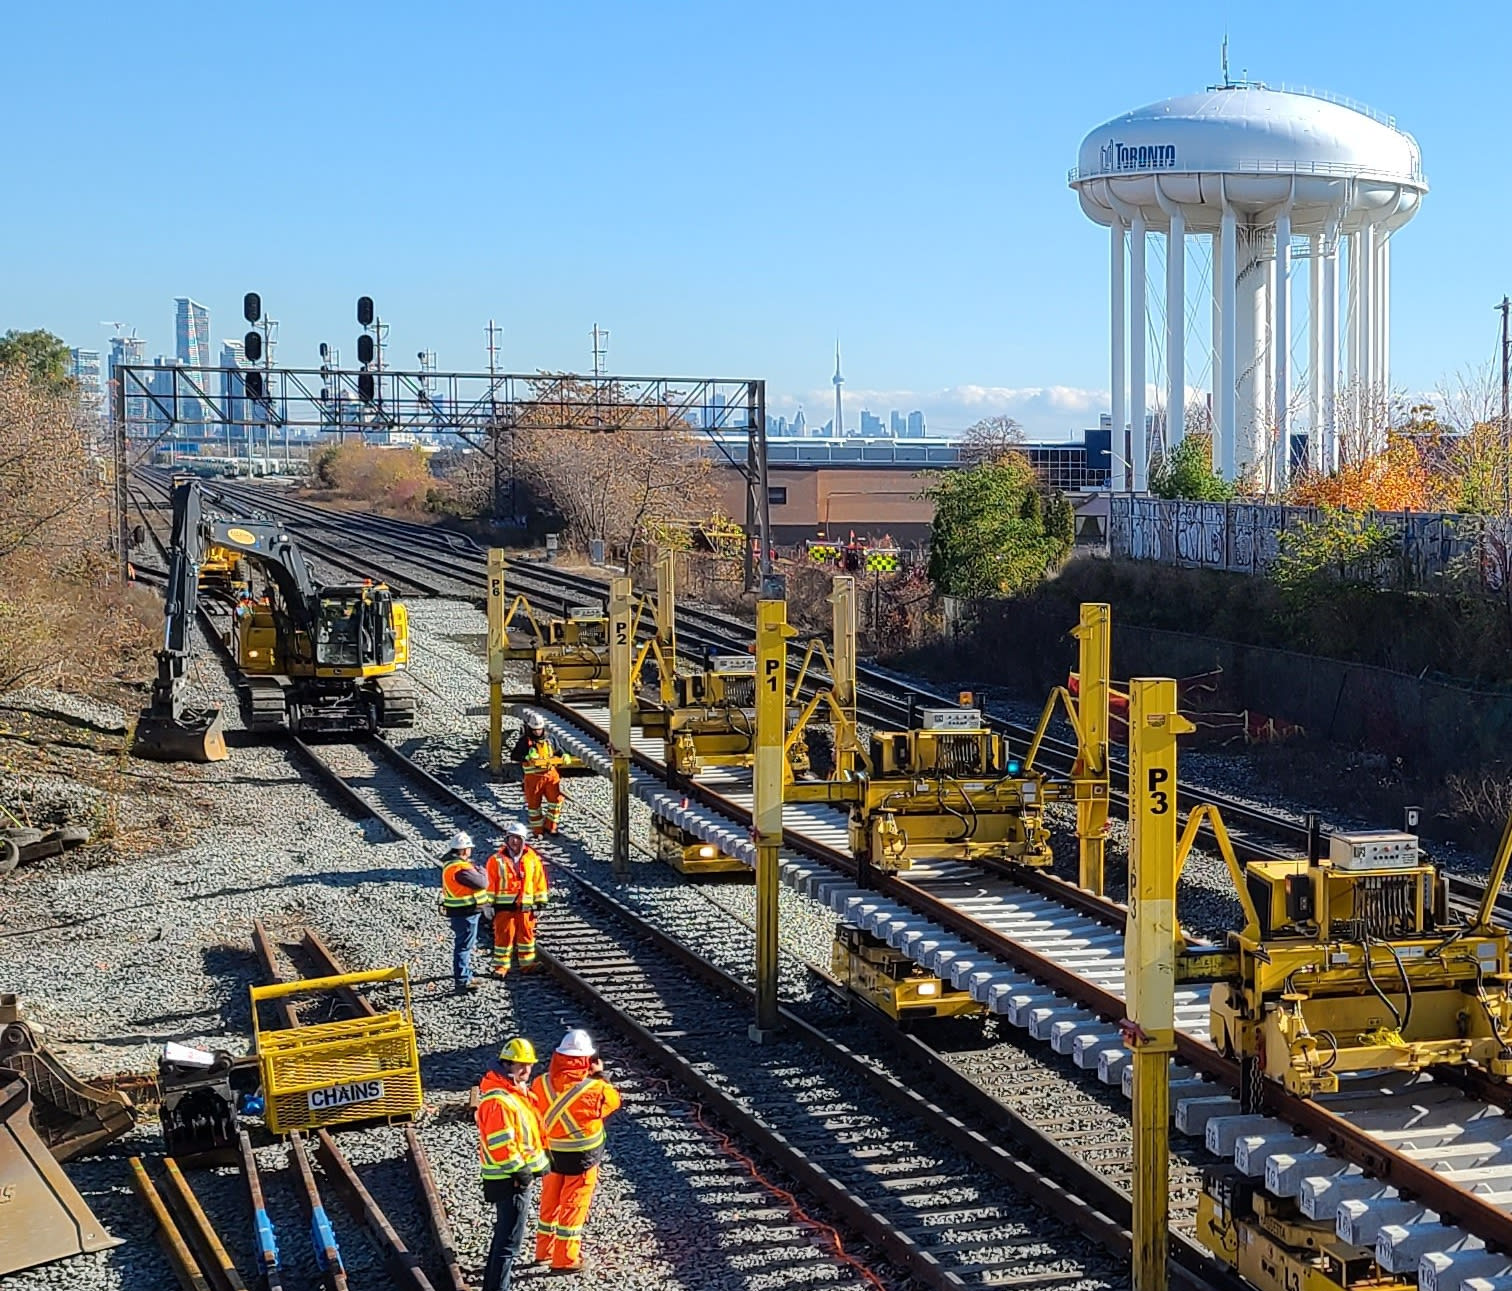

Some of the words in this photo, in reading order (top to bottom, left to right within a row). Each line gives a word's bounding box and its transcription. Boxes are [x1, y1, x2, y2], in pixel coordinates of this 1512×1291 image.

[616, 622, 627, 645] P2
[765, 659, 780, 692] P1
[1148, 768, 1169, 815] P3
[311, 1081, 380, 1107] CHAINS
